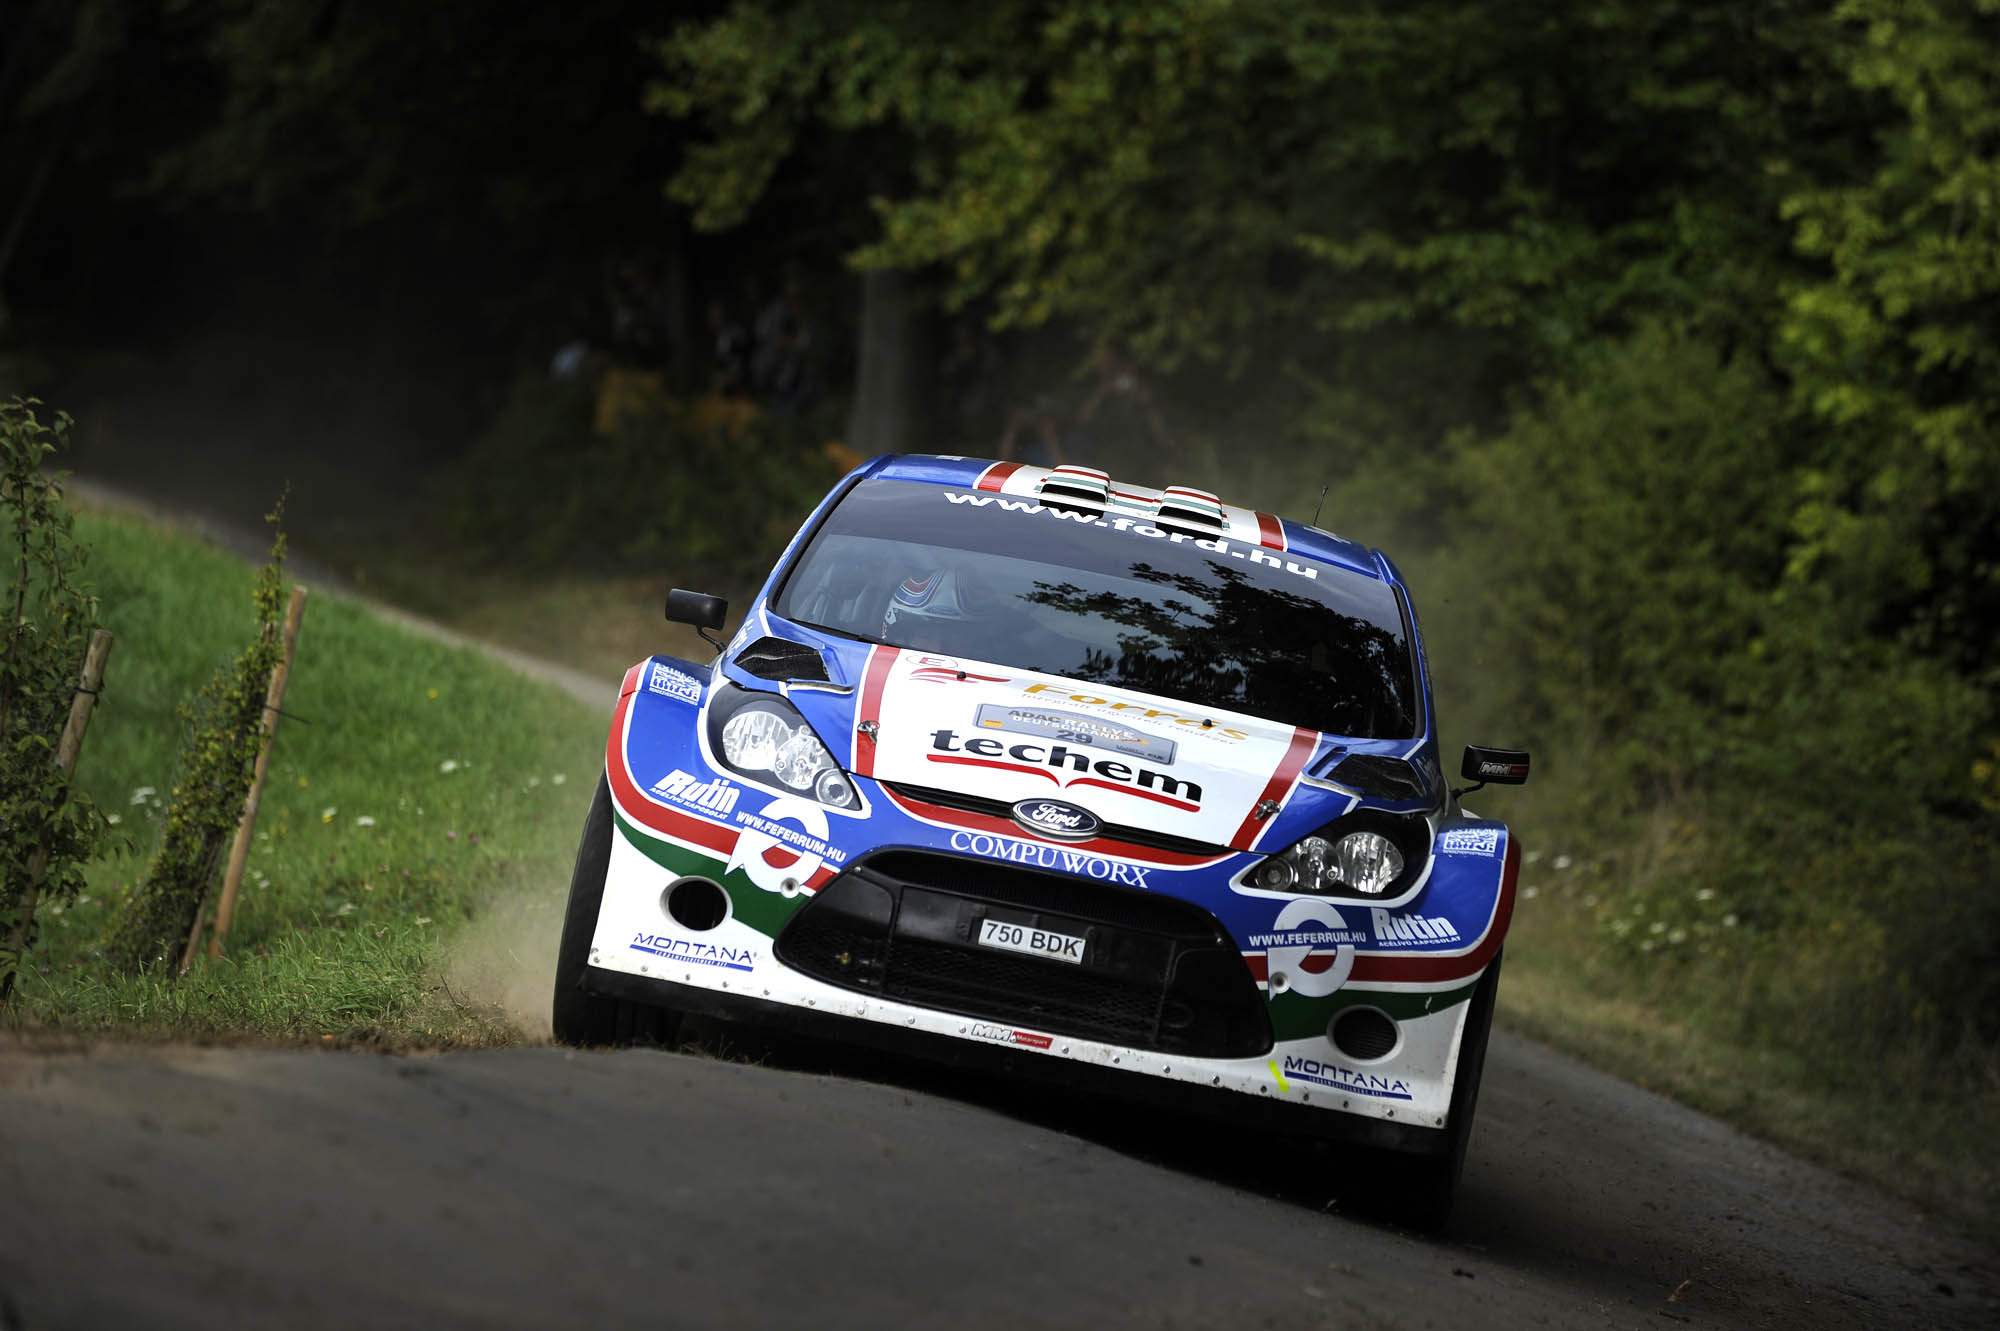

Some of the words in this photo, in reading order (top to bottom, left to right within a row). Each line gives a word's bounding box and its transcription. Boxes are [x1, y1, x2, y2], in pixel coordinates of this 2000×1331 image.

[943, 491, 1319, 580] www.ford.hu
[1007, 709, 1061, 724] ADAC
[1064, 719, 1136, 740] RALLYE
[1012, 715, 1121, 741] DEUTSCHLAND
[1055, 729, 1094, 745] 29
[930, 729, 1204, 804] techem
[653, 768, 740, 815] Rutin
[1030, 802, 1082, 829] Ford
[735, 810, 848, 863] WWW.FEFERRUM.HU
[950, 830, 1152, 889] COMPUWORX
[986, 922, 1024, 946] 750
[1029, 931, 1085, 958] BDK
[1248, 931, 1367, 947] WWW.FEFERRUM.HU
[1370, 907, 1459, 940] Rutin
[633, 932, 753, 965] MONTANA
[970, 1022, 1013, 1043] MM
[1284, 1055, 1409, 1094] MONTANA
